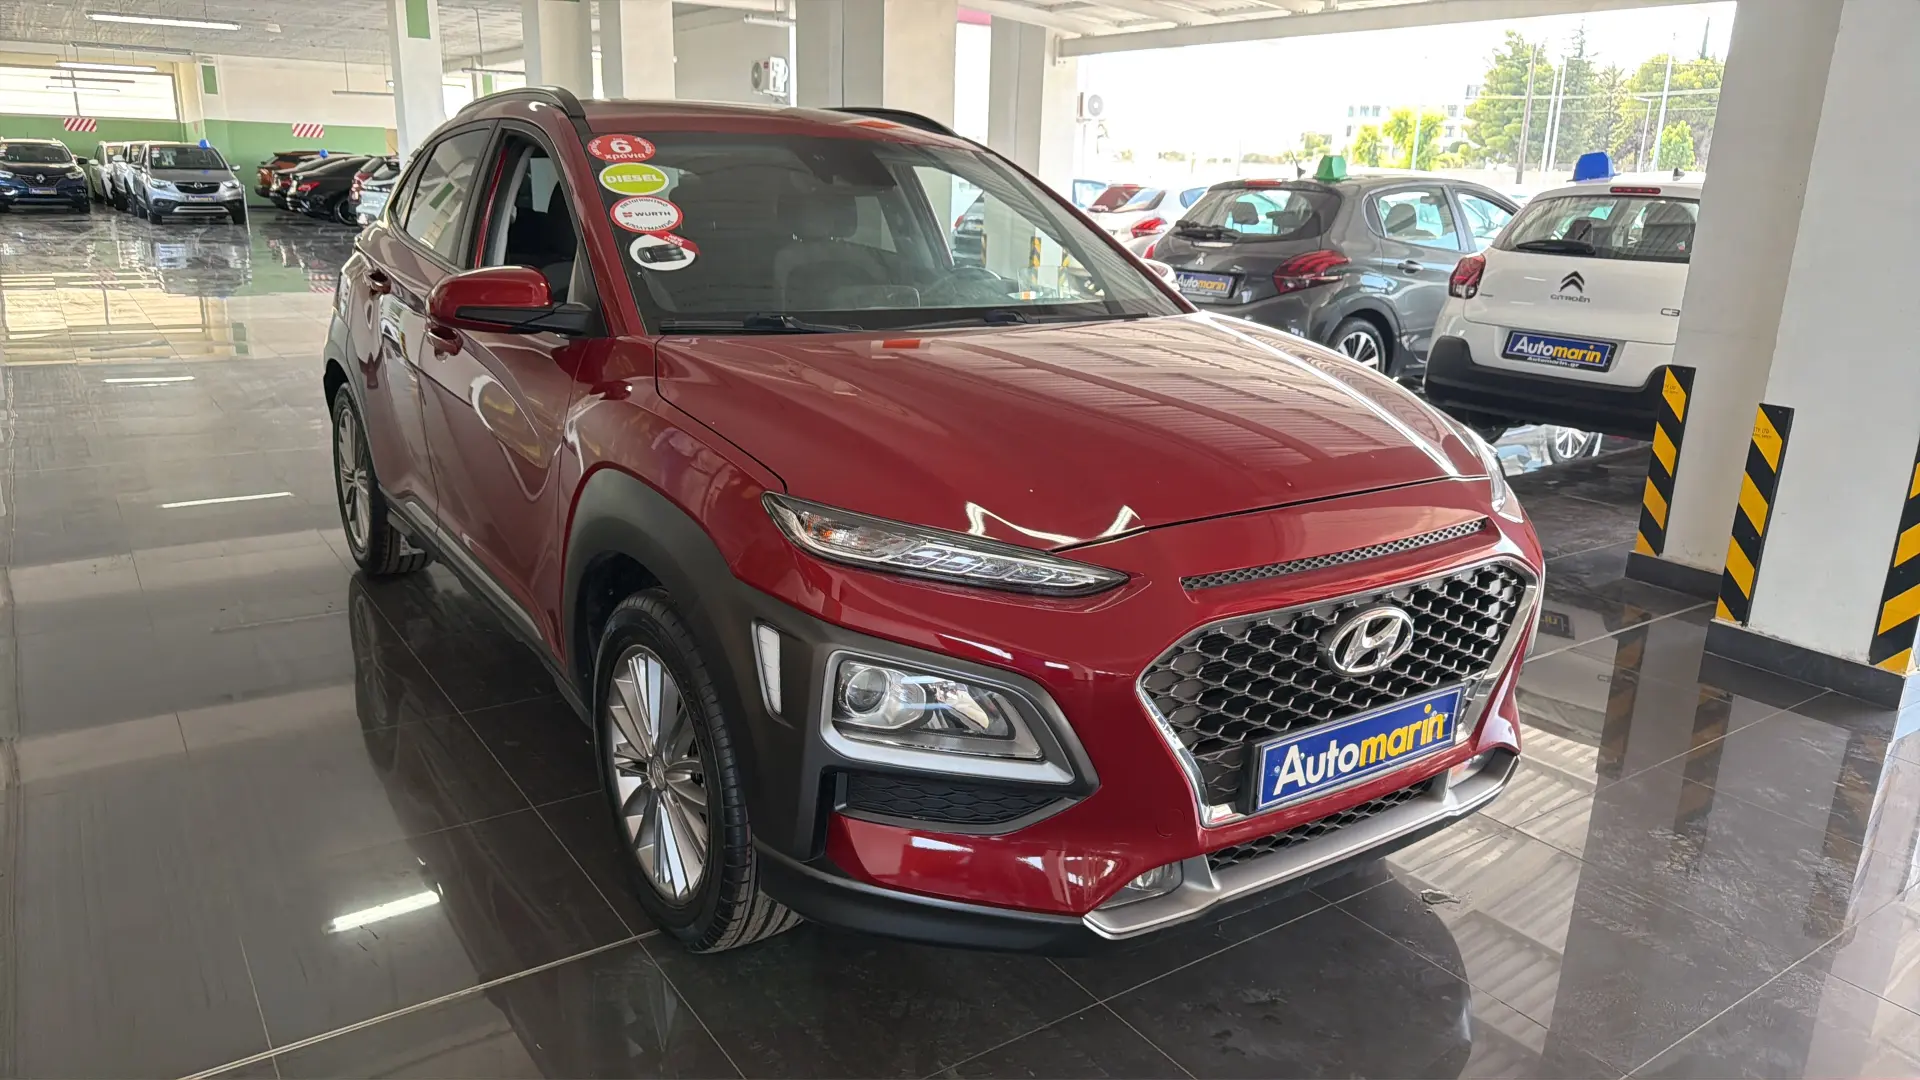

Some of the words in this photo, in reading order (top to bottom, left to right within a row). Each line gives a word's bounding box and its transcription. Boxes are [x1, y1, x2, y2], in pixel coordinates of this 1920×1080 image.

[610, 140, 632, 153] 6
[605, 174, 662, 183] DIESEL
[1177, 273, 1226, 291] Automarin
[1660, 307, 1681, 317] C3
[1513, 336, 1602, 363] Automarin
[1272, 703, 1445, 796] Automarin
